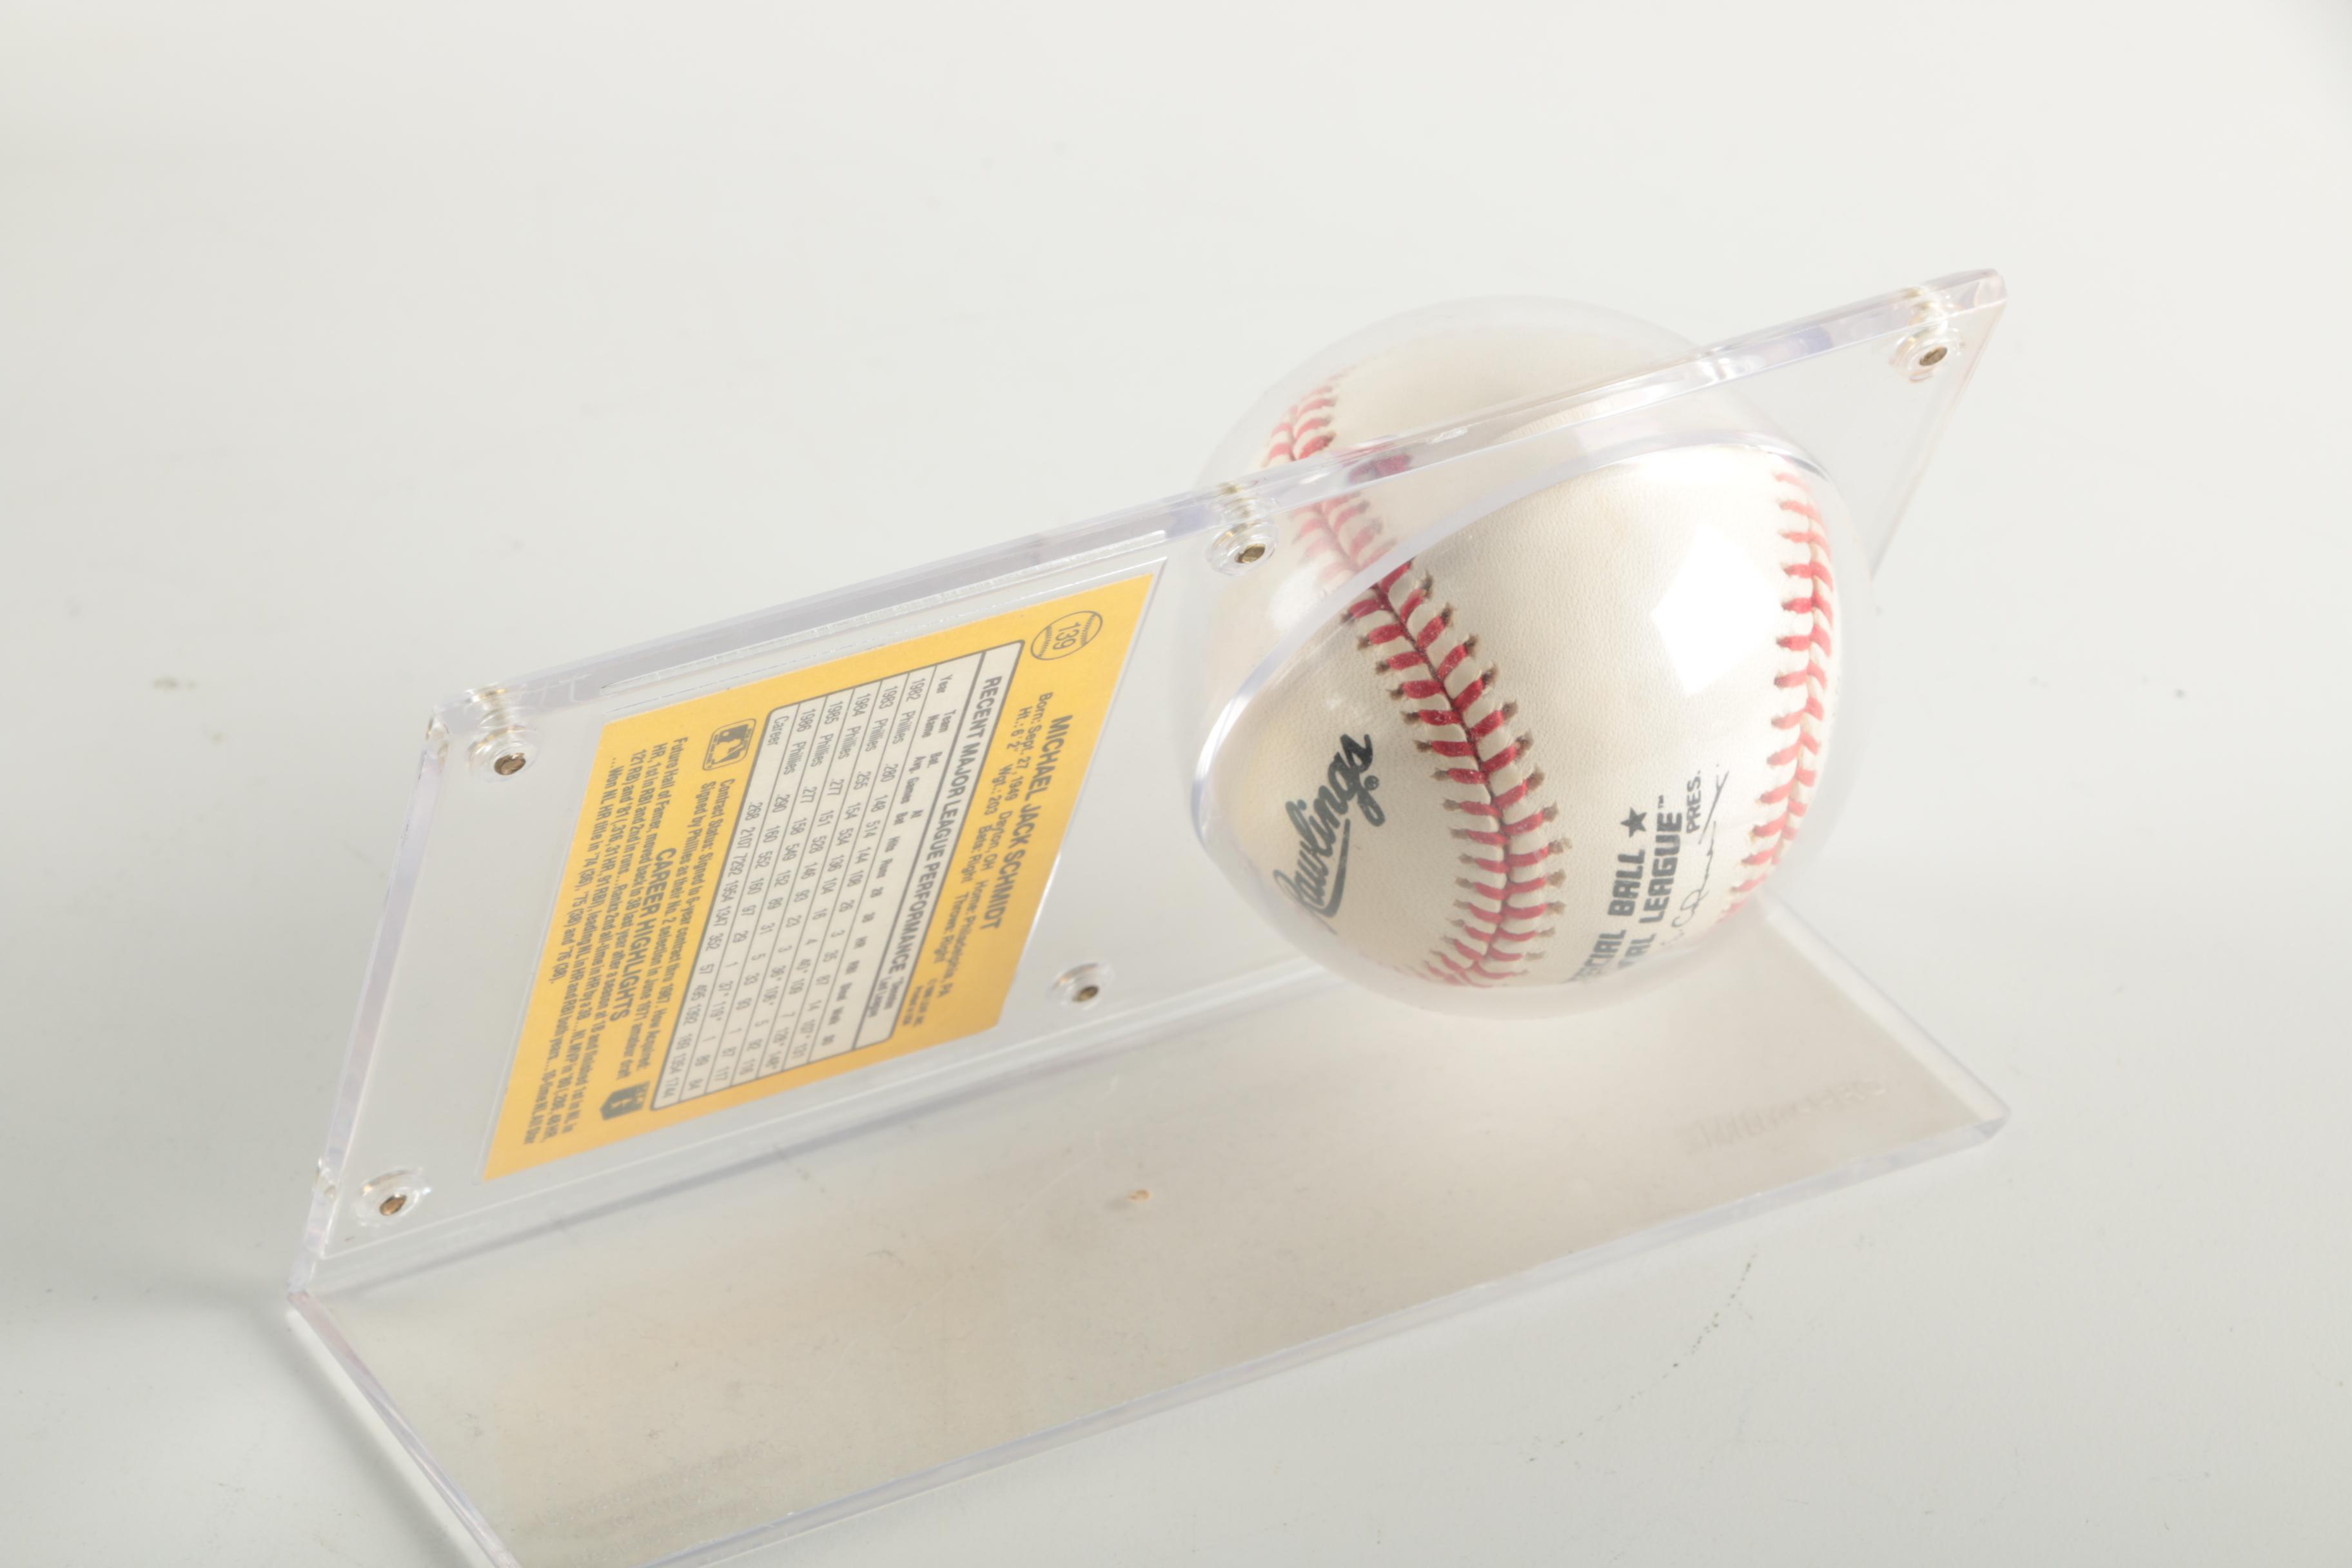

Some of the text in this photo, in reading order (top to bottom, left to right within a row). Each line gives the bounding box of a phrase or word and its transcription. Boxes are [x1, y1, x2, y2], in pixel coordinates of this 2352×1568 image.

[1052, 622, 1081, 650] 139
[905, 678, 925, 701] 1982
[936, 674, 952, 693] Year
[852, 692, 871, 716] 1984
[878, 685, 898, 709] 1983
[823, 700, 843, 725] 1985
[966, 676, 1002, 738] RECENT
[796, 708, 816, 732] 1986
[892, 710, 916, 744] Phillies
[921, 714, 939, 738] Name
[938, 709, 956, 733] Team
[837, 725, 861, 760] Phillies
[865, 718, 888, 752] Phillies
[629, 749, 647, 766] 121
[665, 736, 688, 769] Future
[783, 740, 807, 775] Phillies
[810, 732, 834, 767] Phillies
[644, 761, 662, 778] 1st
[660, 768, 679, 789] Hall
[879, 763, 899, 782] .280
[946, 741, 980, 799] MAJOR
[641, 776, 658, 789] in
[827, 778, 845, 796] .277
[853, 770, 872, 790] .255
[980, 691, 1054, 871] Born: Sept. 27, 1949 Dayton, OH
[600, 789, 618, 805] NL
[619, 784, 634, 803] and
[636, 787, 655, 806] RBI
[656, 789, 671, 799] of
[693, 781, 716, 815] Signed
[710, 778, 736, 818] Contract
[799, 786, 818, 803] .277
[900, 776, 919, 804] Games
[615, 801, 632, 818] '81
[771, 794, 790, 813] .290
[844, 802, 861, 819] 154
[870, 794, 888, 812] 148
[983, 794, 1002, 816] 203
[1686, 770, 1701, 834] PRES.
[595, 803, 614, 821] HR
[631, 806, 647, 825] and
[645, 799, 670, 832] Famer,
[687, 814, 706, 828] by
[817, 809, 834, 827] 151
[893, 811, 908, 825] Bat
[910, 809, 923, 819] At
[979, 714, 1073, 929] MICHAEL JACK SCHMIDT
[590, 820, 608, 841] title
[626, 823, 645, 843] 2nd
[701, 818, 723, 852] Status:
[762, 825, 780, 843] 160
[789, 817, 807, 835] 158
[862, 819, 881, 838] 514
[926, 799, 961, 861] LEAGUE
[1273, 733, 1386, 936] Rawlings
[587, 840, 603, 852] in
[679, 827, 703, 865] Phillies
[699, 715, 789, 974] Career .268 2107 7292 1954 1347 352 57
[808, 835, 827, 854] 528
[836, 827, 854, 846] 534
[884, 836, 900, 852] Hits
[603, 844, 621, 857] 31
[623, 841, 640, 853] in
[638, 832, 658, 864] moved
[781, 843, 799, 861] 549
[854, 847, 871, 864] 144
[691, 852, 714, 885] Signed
[754, 850, 773, 869] 552
[827, 854, 844, 872] 136
[876, 858, 893, 879] Runs
[960, 853, 983, 883] Right
[631, 863, 651, 887] back
[675, 865, 689, 877] as
[773, 869, 791, 887] 152
[800, 861, 818, 879] 146
[846, 869, 864, 887] 108
[629, 886, 644, 897] to
[669, 876, 688, 899] their
[687, 885, 703, 896] to
[747, 877, 764, 895] 160
[820, 877, 838, 894] 104
[1607, 848, 1645, 916] BALL
[625, 896, 642, 910] 3B
[767, 897, 783, 910] 89
[793, 888, 810, 903] 93
[680, 896, 700, 925] 6-year
[741, 904, 756, 916] 97
[812, 908, 828, 920] 16
[838, 899, 855, 912] 26
[601, 912, 620, 930] 2nd
[620, 910, 638, 929] last
[785, 914, 802, 928] 23
[888, 861, 941, 974] PERFORMANCE
[560, 927, 576, 946] and
[576, 910, 602, 946] leading
[609, 847, 676, 1021] CAREER HIGHLIGHTS
[732, 930, 749, 943] 29
[759, 922, 775, 935] 31
[614, 928, 630, 948] year
[649, 925, 671, 966] selection
[667, 926, 689, 963] contract
[608, 949, 625, 970] after
[646, 966, 662, 977] in
